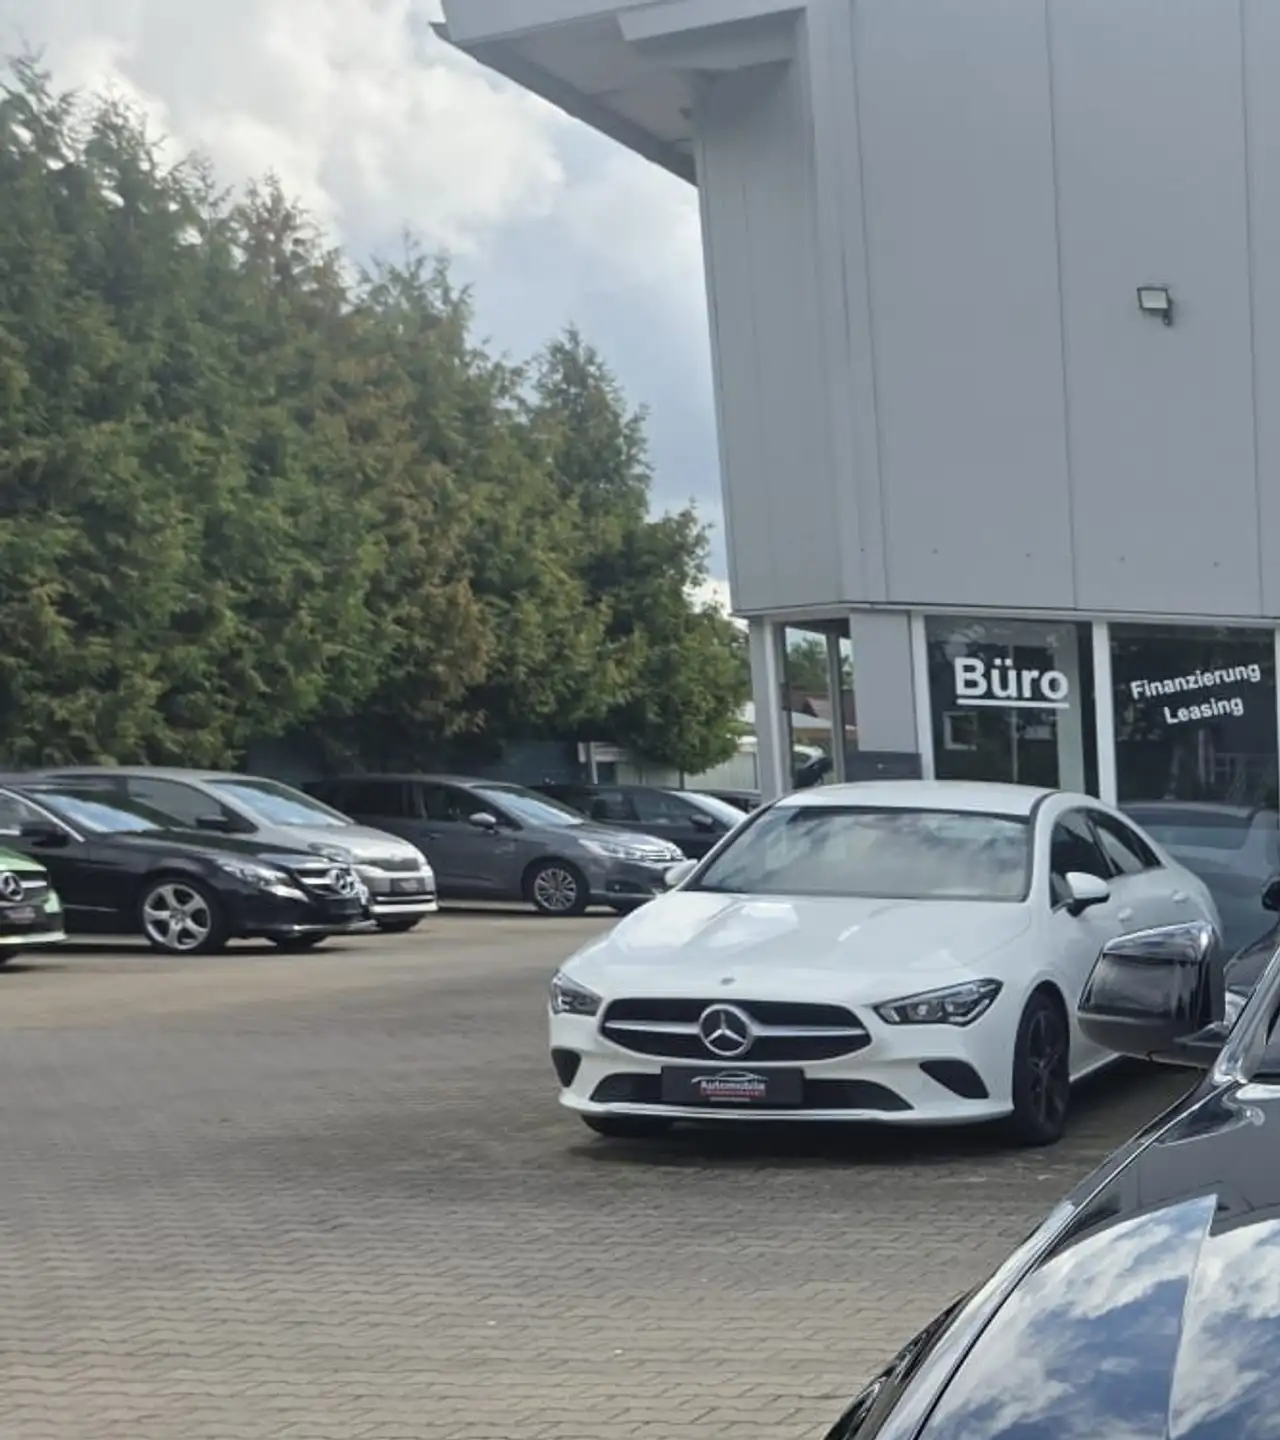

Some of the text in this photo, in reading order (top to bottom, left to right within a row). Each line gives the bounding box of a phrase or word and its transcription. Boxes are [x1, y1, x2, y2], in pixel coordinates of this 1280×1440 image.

[954, 656, 1070, 700] Büro
[1130, 663, 1261, 700] Finanzierung
[1164, 696, 1244, 724] Leasing
